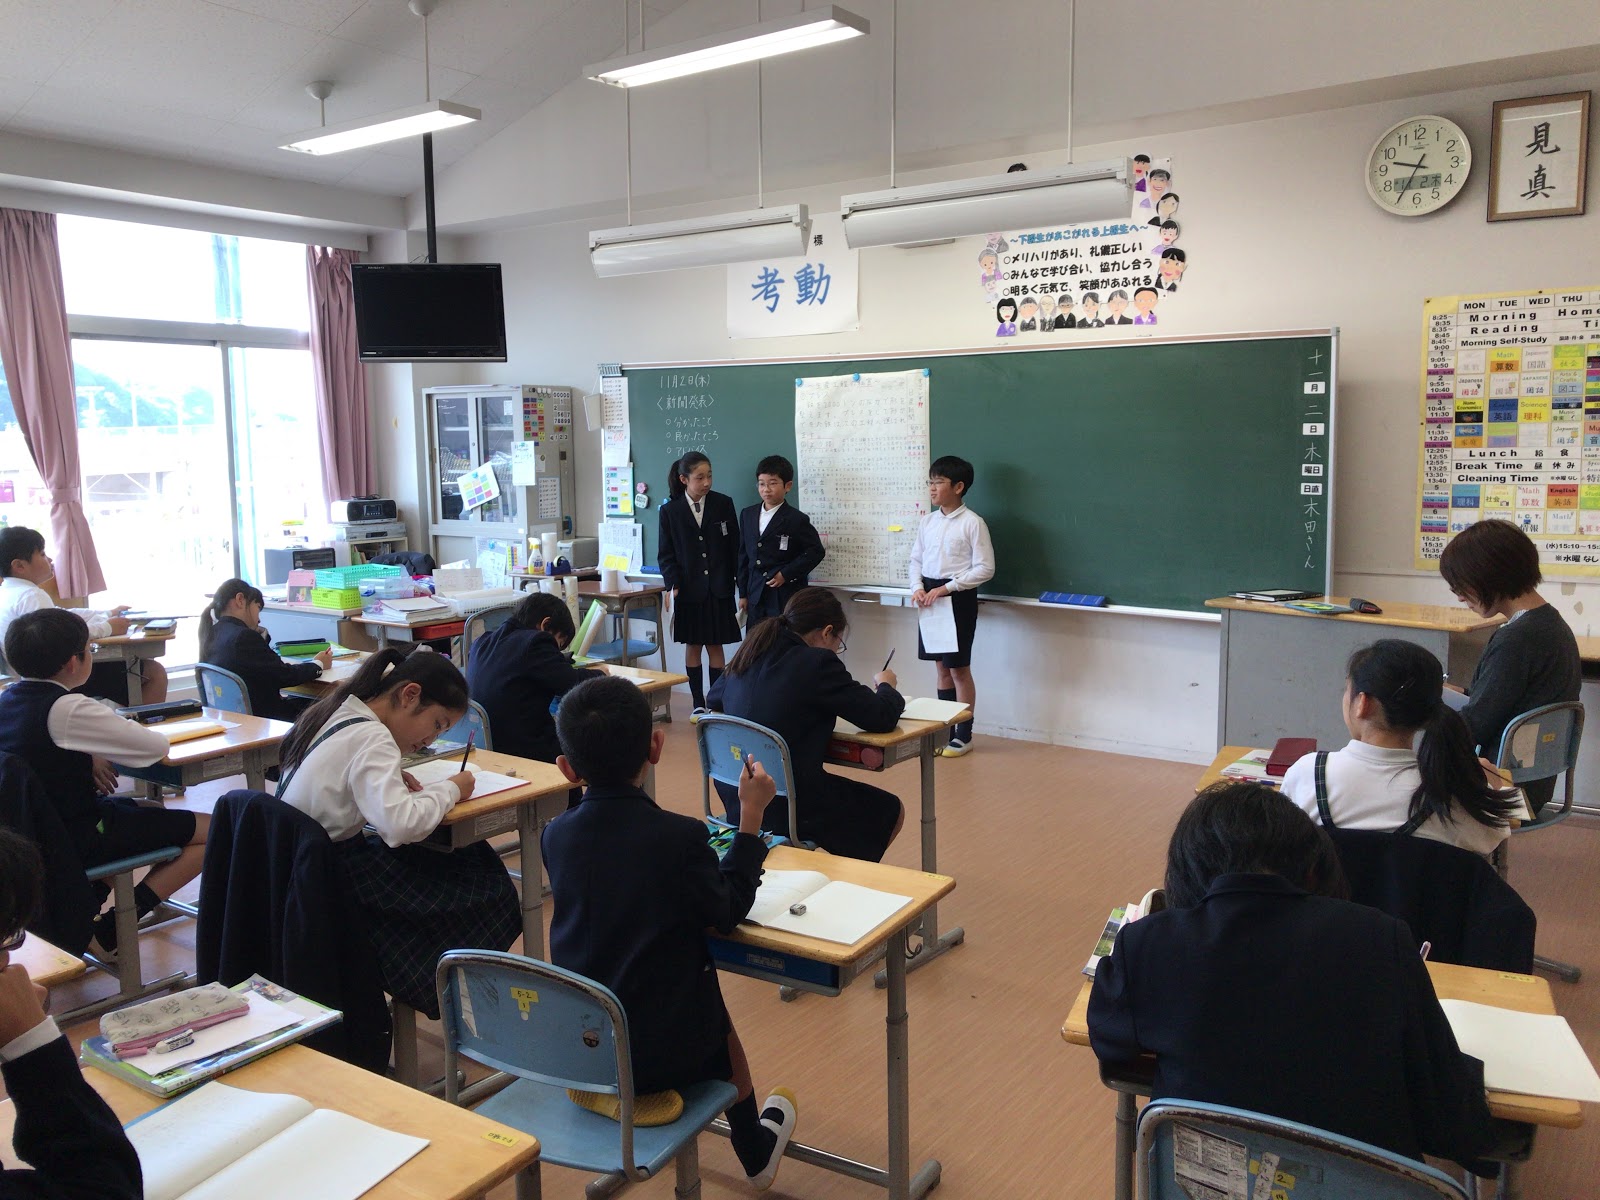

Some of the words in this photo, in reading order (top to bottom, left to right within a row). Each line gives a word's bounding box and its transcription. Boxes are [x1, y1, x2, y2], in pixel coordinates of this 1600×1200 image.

[1414, 127, 1426, 140] 12
[1436, 130, 1440, 141] 1
[1398, 134, 1408, 146] 11
[1446, 140, 1456, 152] 2
[1383, 147, 1396, 160] 10
[1450, 156, 1460, 168] 3
[1520, 121, 1560, 200] 見真
[1379, 164, 1389, 177] 9
[1431, 175, 1441, 187] 木
[1443, 174, 1453, 185] 4
[1383, 180, 1392, 192] 8
[1412, 193, 1422, 205] 6
[1431, 188, 1440, 199] 5
[813, 234, 823, 246] 標
[751, 263, 831, 313] 考動
[1464, 302, 1486, 310] MON
[1529, 297, 1550, 305] WED
[1470, 312, 1537, 322] Morning
[1471, 324, 1538, 334] Reading
[1461, 339, 1497, 347] Morning
[1500, 336, 1548, 345] Self-Study
[1496, 362, 1514, 370] 算数
[1527, 360, 1546, 369] 国語
[660, 372, 710, 388] 11月2日(木)
[1461, 388, 1479, 396] 国語
[1526, 386, 1544, 394] 国語
[1559, 385, 1577, 393] 図工
[1493, 412, 1512, 421] 英語
[1523, 412, 1542, 420] 理科
[1469, 449, 1517, 457] Lunch
[1455, 462, 1488, 470] Break
[1457, 474, 1506, 484] Cleaning
[1510, 474, 1539, 482] Time
[1457, 497, 1475, 506] 理科
[1485, 495, 1500, 503] 社会
[1521, 498, 1540, 507] 算数
[1520, 524, 1539, 532] 情報
[1277, 1174, 1287, 1184] 2
